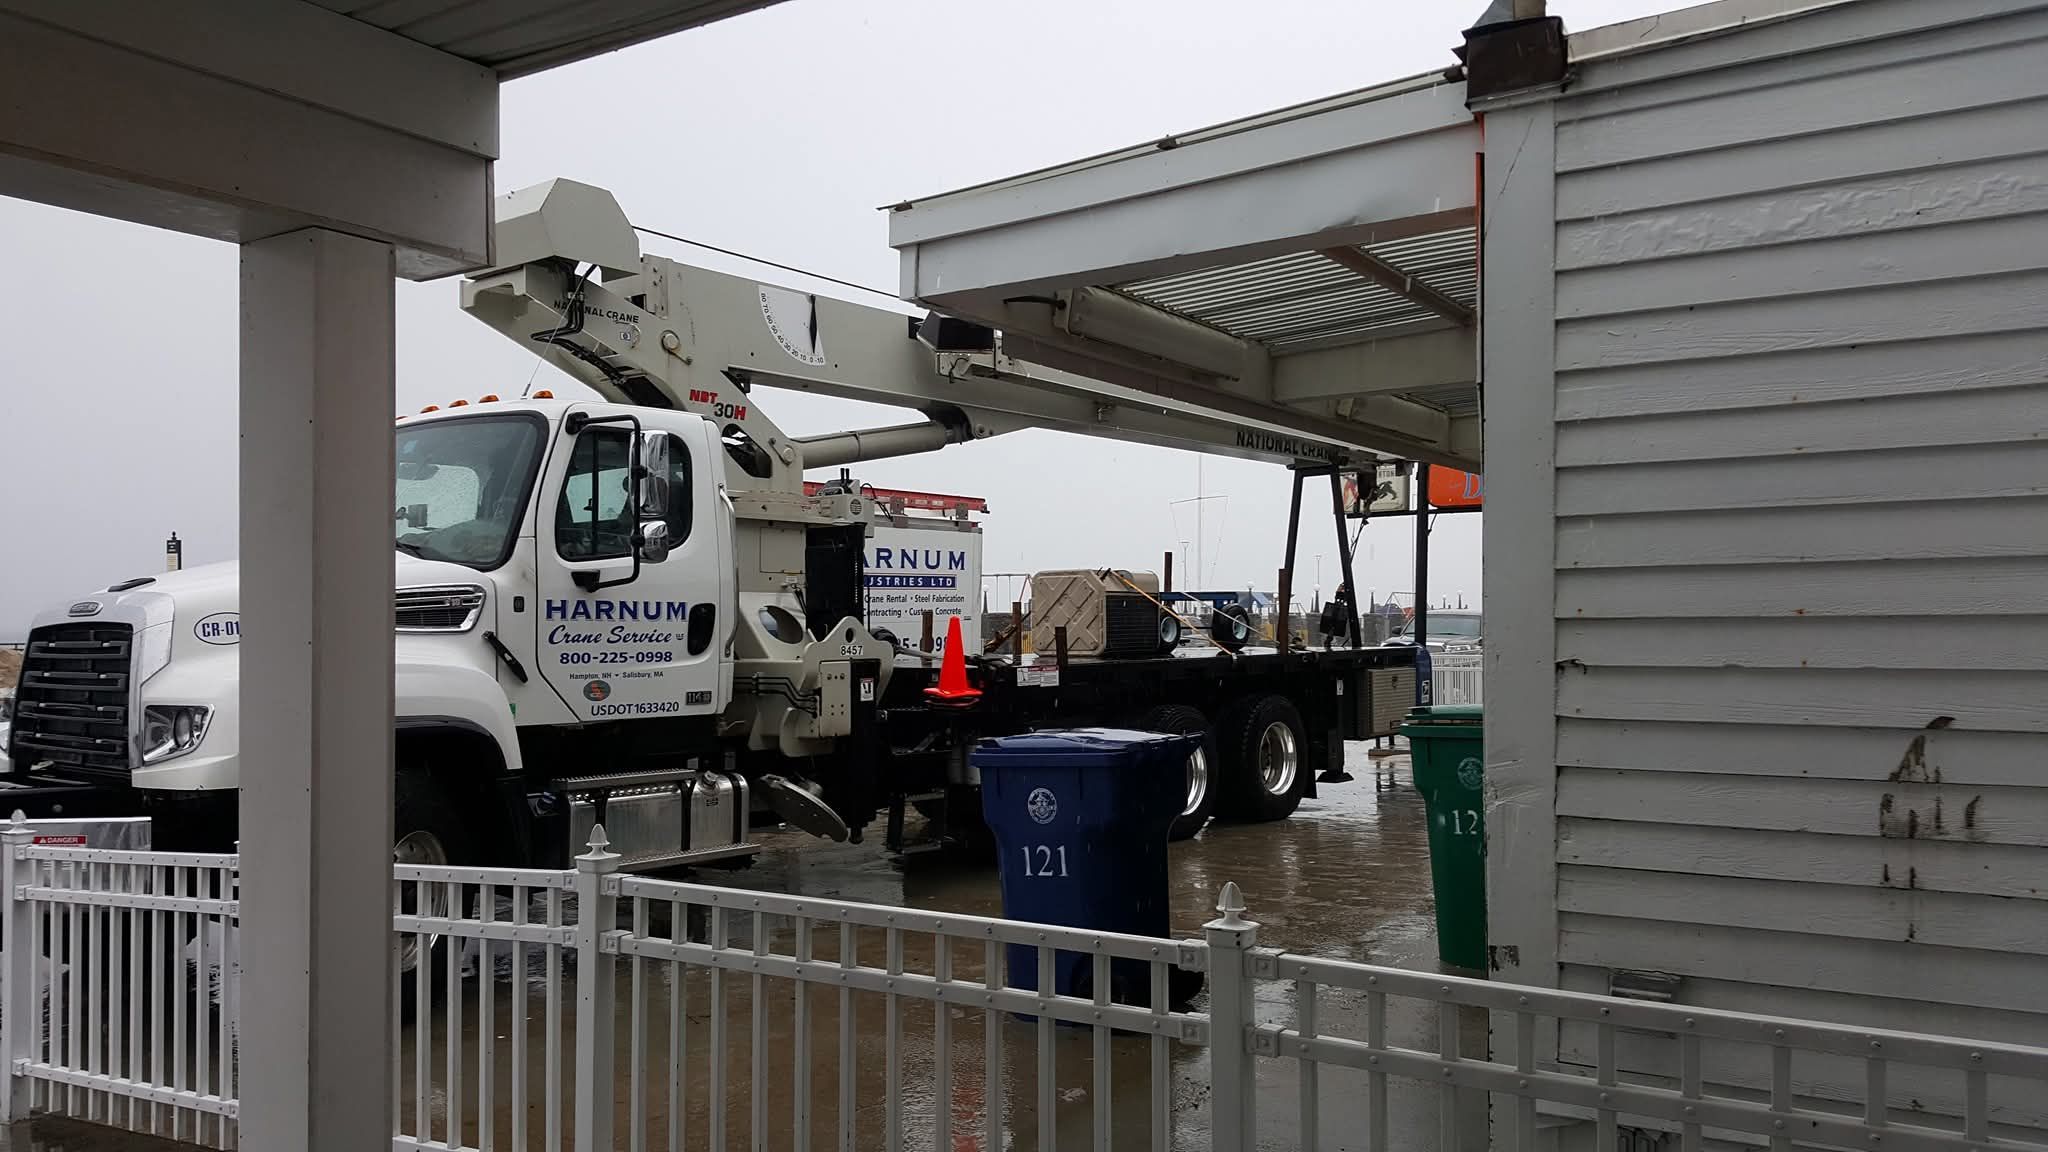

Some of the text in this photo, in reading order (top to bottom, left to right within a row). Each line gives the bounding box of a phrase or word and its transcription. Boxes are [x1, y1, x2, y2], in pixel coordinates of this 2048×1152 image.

[606, 310, 639, 324] CRANE
[783, 343, 792, 351] 30
[791, 349, 799, 357] 20
[689, 389, 719, 404] NBT
[714, 402, 747, 421] 30H
[1236, 431, 1299, 455] NATIONAL
[931, 578, 953, 587] LTD
[886, 594, 908, 603] Rental
[914, 594, 931, 603] Steel
[932, 594, 965, 603] Fabrication
[546, 599, 688, 621] HARNUM
[863, 607, 962, 618] Cntracting Cust Concrete
[202, 621, 240, 637] CR-01
[548, 624, 602, 645] Crane
[606, 625, 672, 644] Service
[560, 651, 673, 664] 800-225-0998
[840, 645, 863, 656] 8457
[622, 671, 652, 679] Salisbury,
[591, 702, 680, 716] USDOT1633420
[1022, 844, 1069, 877] 121
